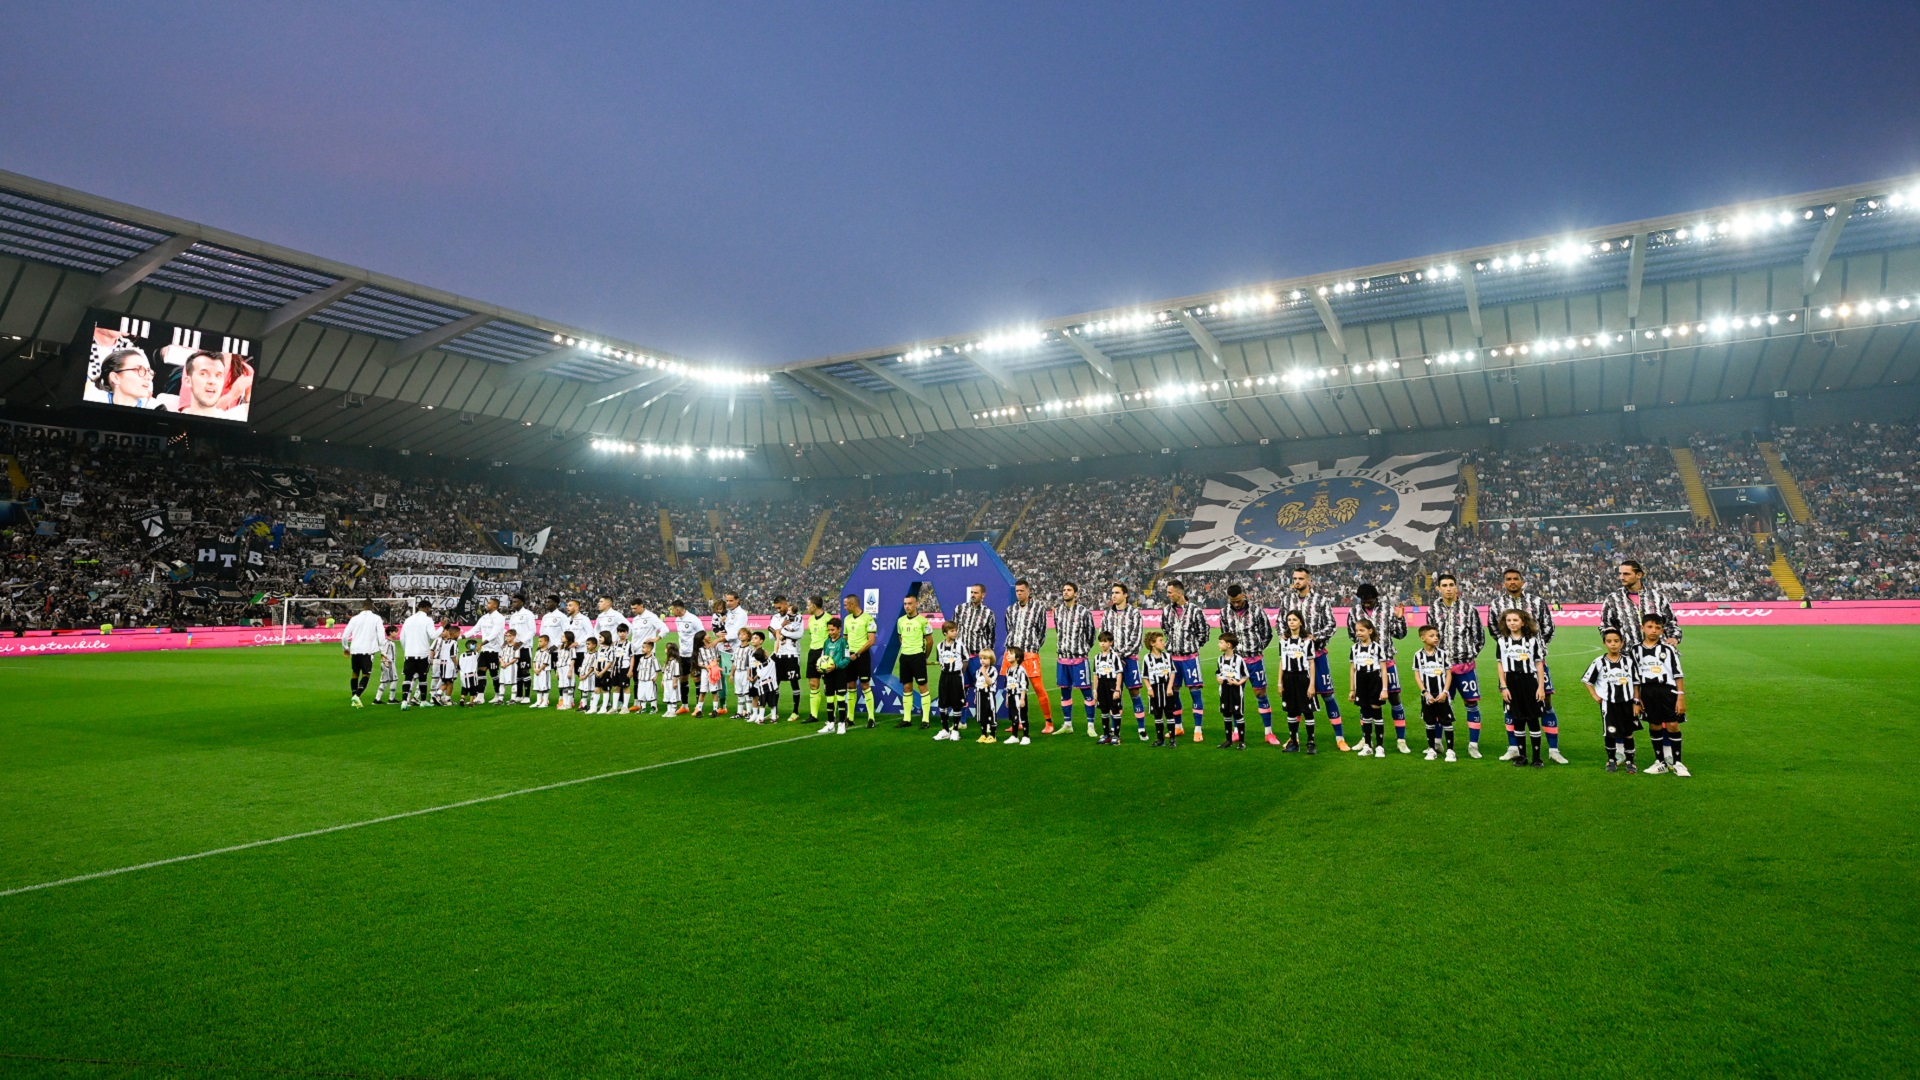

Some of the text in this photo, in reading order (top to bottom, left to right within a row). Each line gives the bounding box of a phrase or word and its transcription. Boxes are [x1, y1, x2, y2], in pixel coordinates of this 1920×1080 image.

[1228, 472, 1322, 511] FUARCE
[871, 556, 908, 571] SERIE
[951, 553, 978, 568] TIM
[20, 638, 110, 652] sostenibile
[1032, 661, 1037, 669] 1
[1080, 670, 1085, 679] 5
[1132, 670, 1138, 680] 7
[1187, 668, 1197, 678] 14
[1255, 671, 1265, 681] 17
[1387, 672, 1396, 684] 11
[1322, 674, 1331, 686] 15
[1462, 680, 1477, 692] 20
